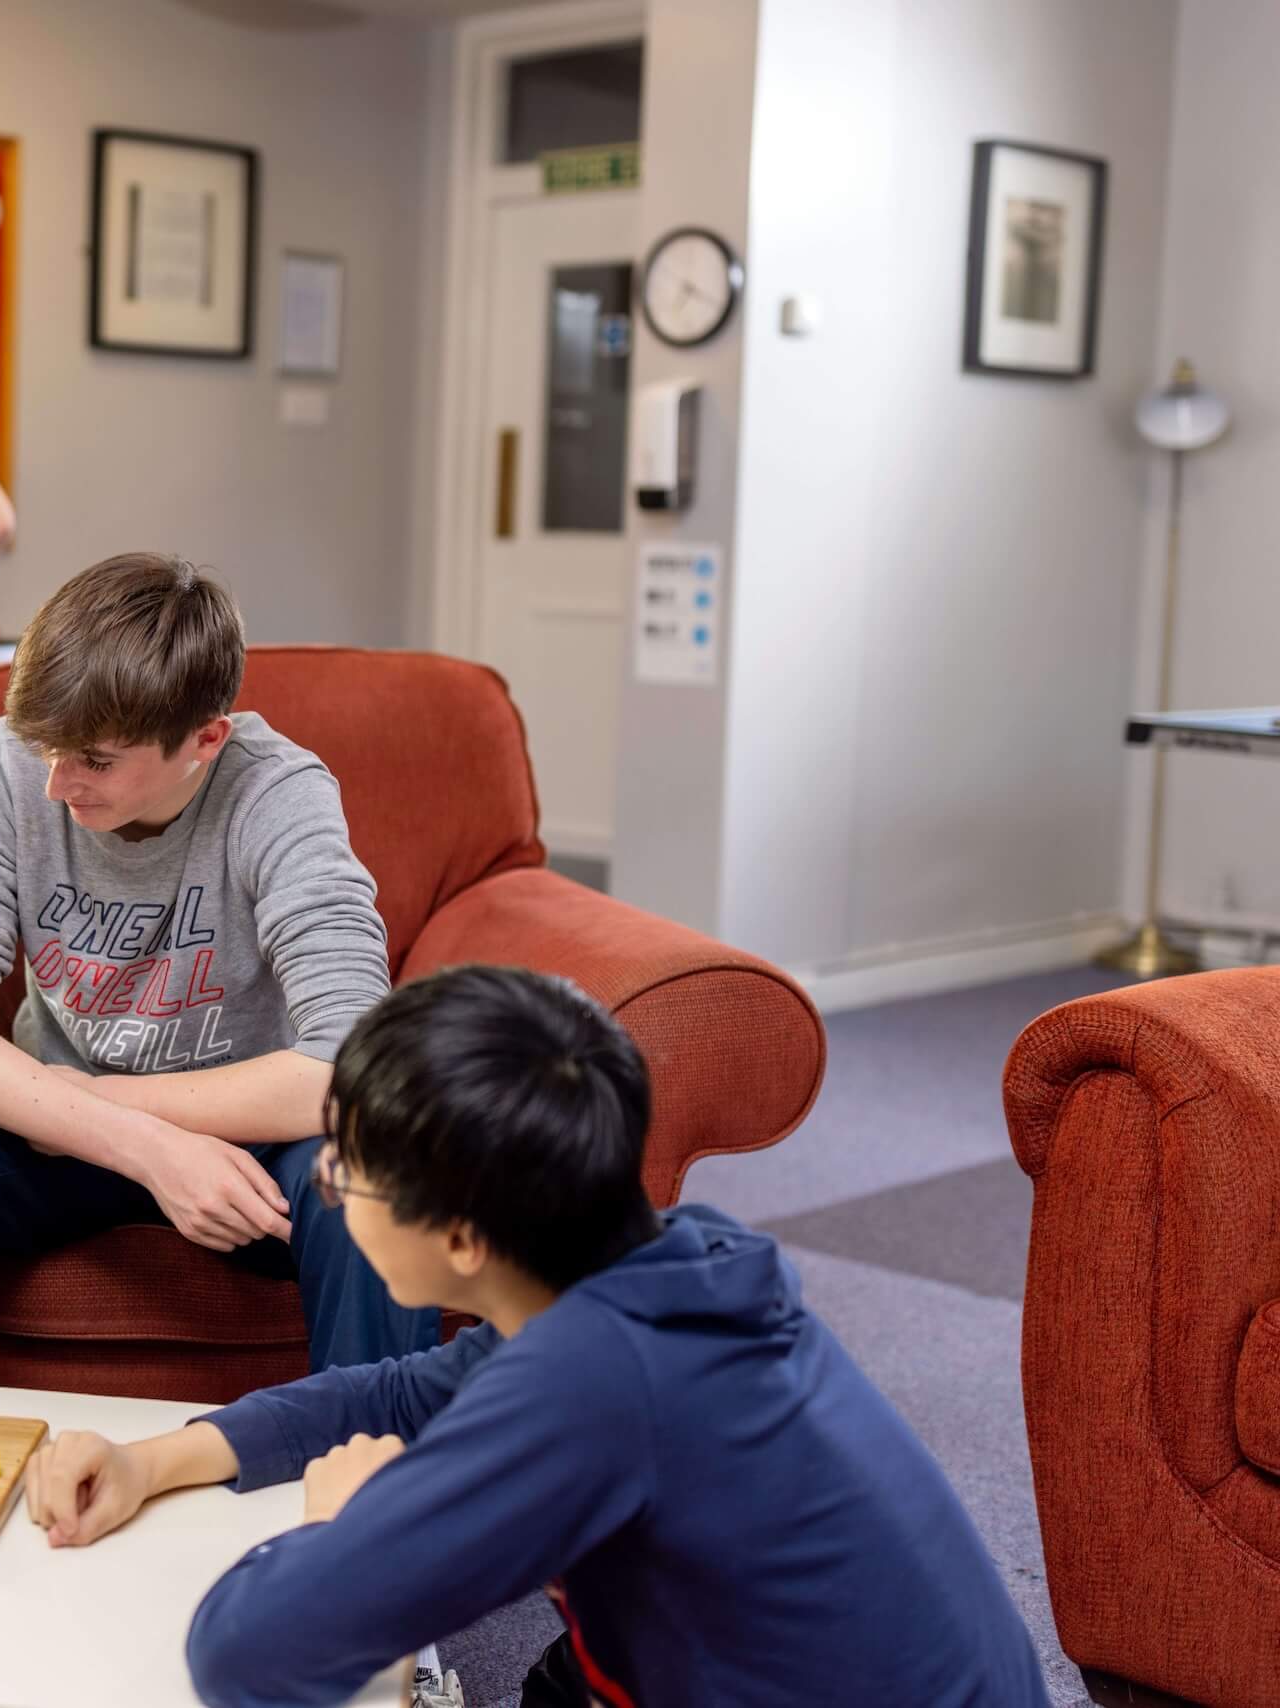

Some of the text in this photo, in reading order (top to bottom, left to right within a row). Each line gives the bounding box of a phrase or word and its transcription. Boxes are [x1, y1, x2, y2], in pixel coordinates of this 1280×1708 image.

[31, 938, 225, 1017] O'NEILL
[45, 997, 233, 1073] 'NEILL
[416, 1666, 432, 1677] NIKE
[428, 1677, 440, 1686] AIR
